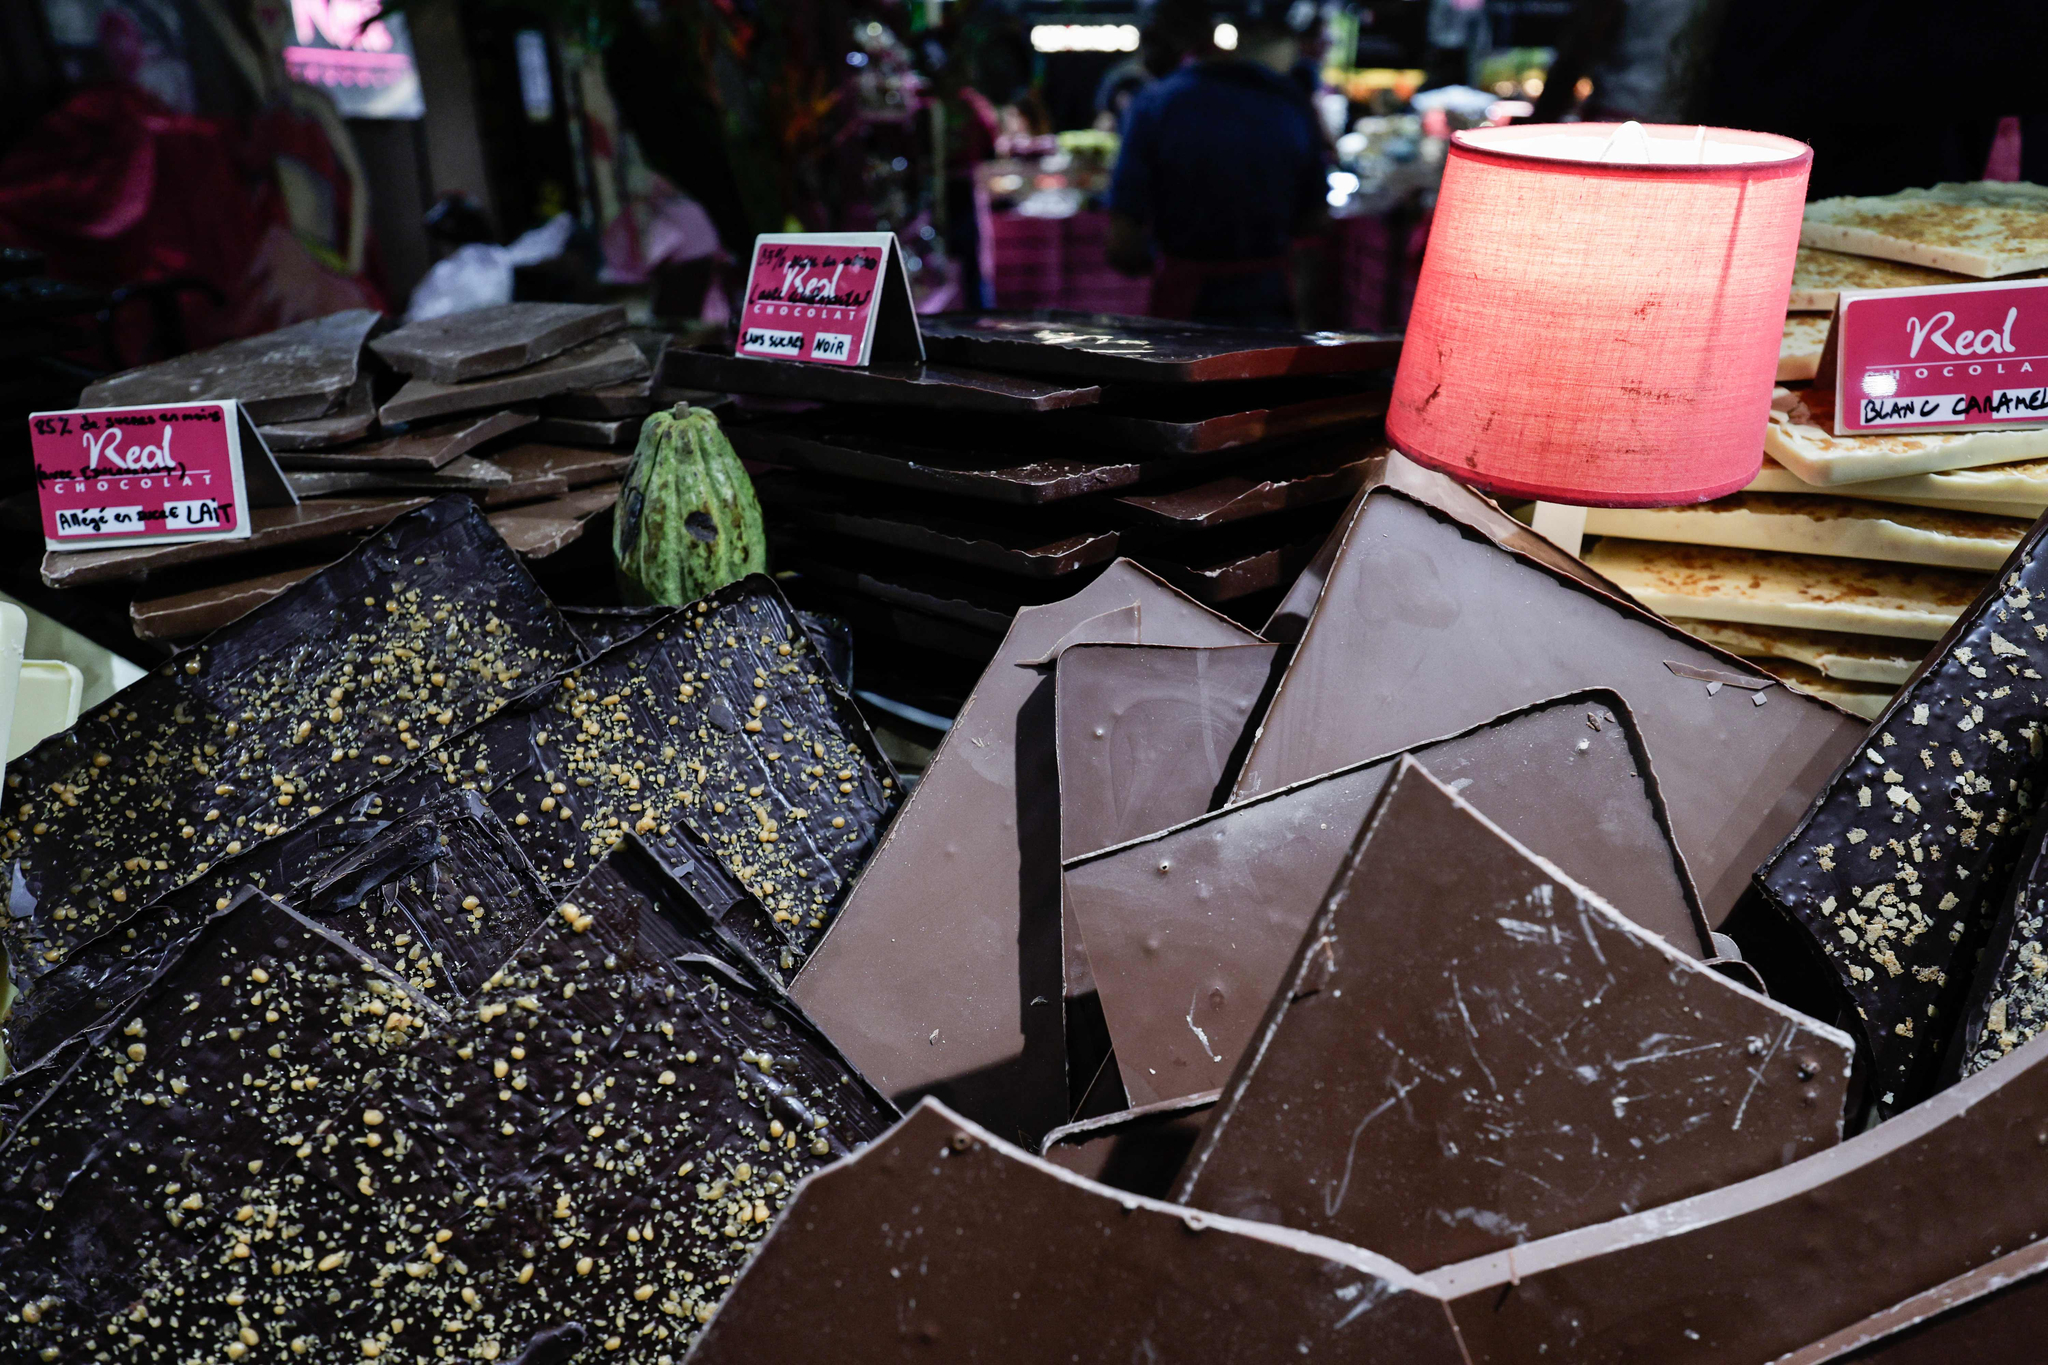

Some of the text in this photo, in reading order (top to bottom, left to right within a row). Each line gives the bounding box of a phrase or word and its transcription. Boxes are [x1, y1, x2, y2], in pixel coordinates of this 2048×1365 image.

[783, 259, 844, 300] Real
[753, 304, 856, 321] CHOCOLAT
[1906, 306, 2018, 359] Real
[1864, 361, 2033, 381] HOCOLA
[1864, 387, 2048, 424] BLANC CARAMEL
[83, 424, 177, 470] Real
[54, 474, 212, 494] CHOCOLAT
[114, 512, 133, 523] en
